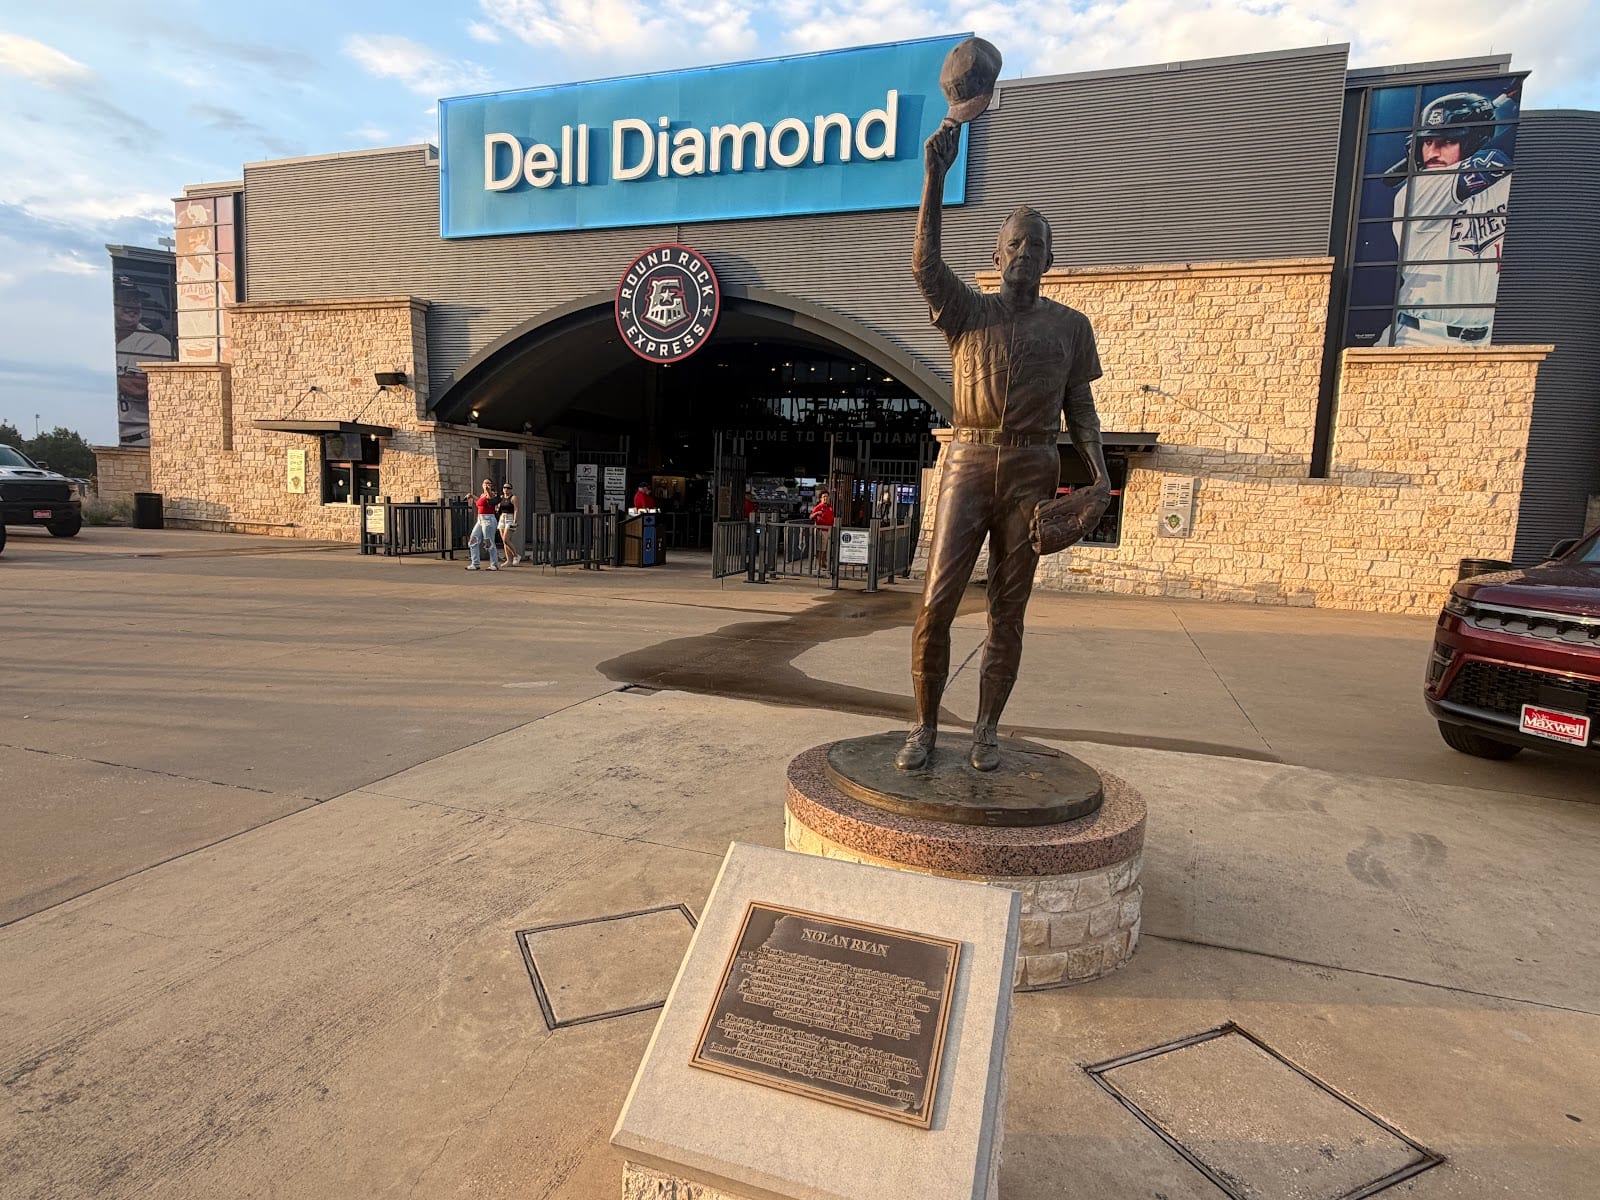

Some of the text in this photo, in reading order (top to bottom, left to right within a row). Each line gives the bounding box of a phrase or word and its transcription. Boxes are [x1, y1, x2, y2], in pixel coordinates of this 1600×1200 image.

[484, 89, 898, 191] Dell Diamond
[621, 249, 714, 299] ROUND ROCK
[626, 324, 705, 356] EXPRESS
[1524, 715, 1585, 738] Maxwell
[801, 928, 891, 958] NOLAN RYAN
